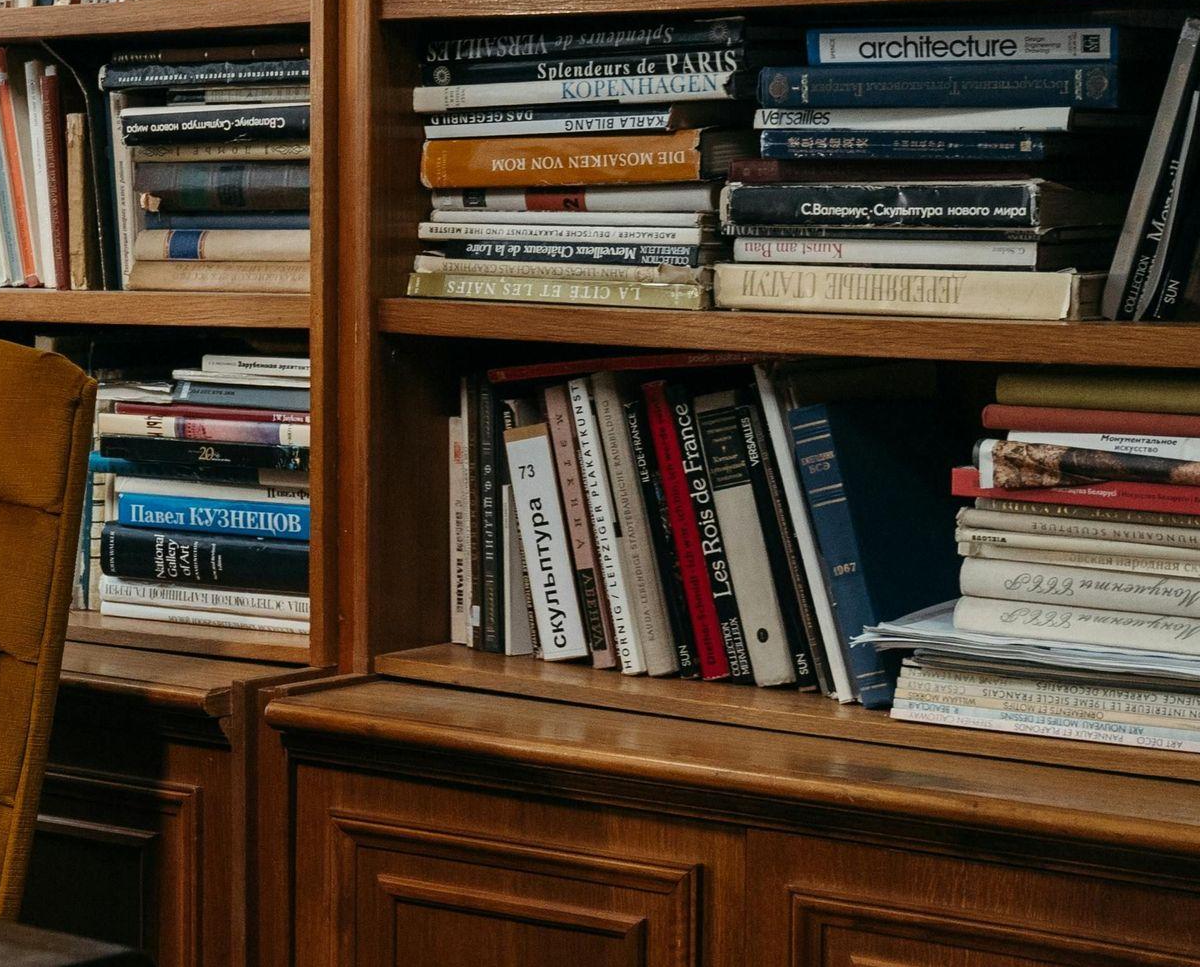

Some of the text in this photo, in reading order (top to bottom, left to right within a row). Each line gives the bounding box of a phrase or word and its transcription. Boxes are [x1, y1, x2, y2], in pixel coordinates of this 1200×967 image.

[425, 23, 674, 62] Splendeurs de VERSAILLES
[858, 30, 1018, 59] architecture
[536, 49, 737, 82] Splendeurs de PARIS
[560, 72, 717, 100] KOPENHAGEN
[125, 123, 178, 134] нового мира
[430, 109, 532, 124] DAS GEGENBILD
[563, 113, 664, 131] KARLA BILANG
[760, 109, 830, 125] Versailles
[490, 150, 684, 171] DIE MOSAIKEN VON ROM
[872, 203, 1026, 218] Скульптура нового мира
[427, 226, 675, 238] RADEMACHER DEUTSCHE PLAKATKUNST UND MEISTER
[465, 242, 636, 260] Merveilleux Châteaux de la Loire
[639, 243, 690, 265] COLLECTION MERVEILLEUX
[743, 240, 842, 257] Kunst am Bau
[445, 280, 639, 300] LA CITÉ LES NAÏFS
[741, 269, 966, 303] ДЕРЕВЯННЫЕ СТАТУИ
[1123, 253, 1151, 314] COLLECTION
[1161, 278, 1183, 305] SUN
[626, 411, 650, 483] ILE-DE-FRANCE
[671, 401, 702, 474] France
[739, 415, 761, 467] VERSAILLES
[1099, 433, 1178, 446] Монументальное
[1113, 444, 1158, 455] искусство
[517, 464, 536, 480] 73
[688, 476, 711, 506] de
[129, 503, 302, 538] Павел КУЗНЕЦОВ
[569, 382, 633, 670] HORNIG LEIPZIGER PLAKATKUNST
[696, 507, 723, 555] Rois
[1029, 519, 1198, 545] HUNGARIAN SCULPTURE
[153, 533, 165, 578] National
[165, 538, 179, 577] Gallery
[179, 544, 191, 576] of Art
[1115, 555, 1180, 574] народная
[528, 495, 570, 649] скульптура
[708, 559, 733, 598] Les
[832, 562, 858, 577] 1967
[1003, 570, 1200, 608] Монументы СССР
[999, 605, 1200, 642] Монументы СССР
[678, 643, 692, 667] SUN
[721, 621, 741, 676] COLLECTION
[729, 616, 751, 675] MERVEILLEUX
[796, 652, 808, 675] SUN
[1045, 715, 1143, 734] ART MOTIFS
[1077, 728, 1183, 748] ART PANNEAUX
